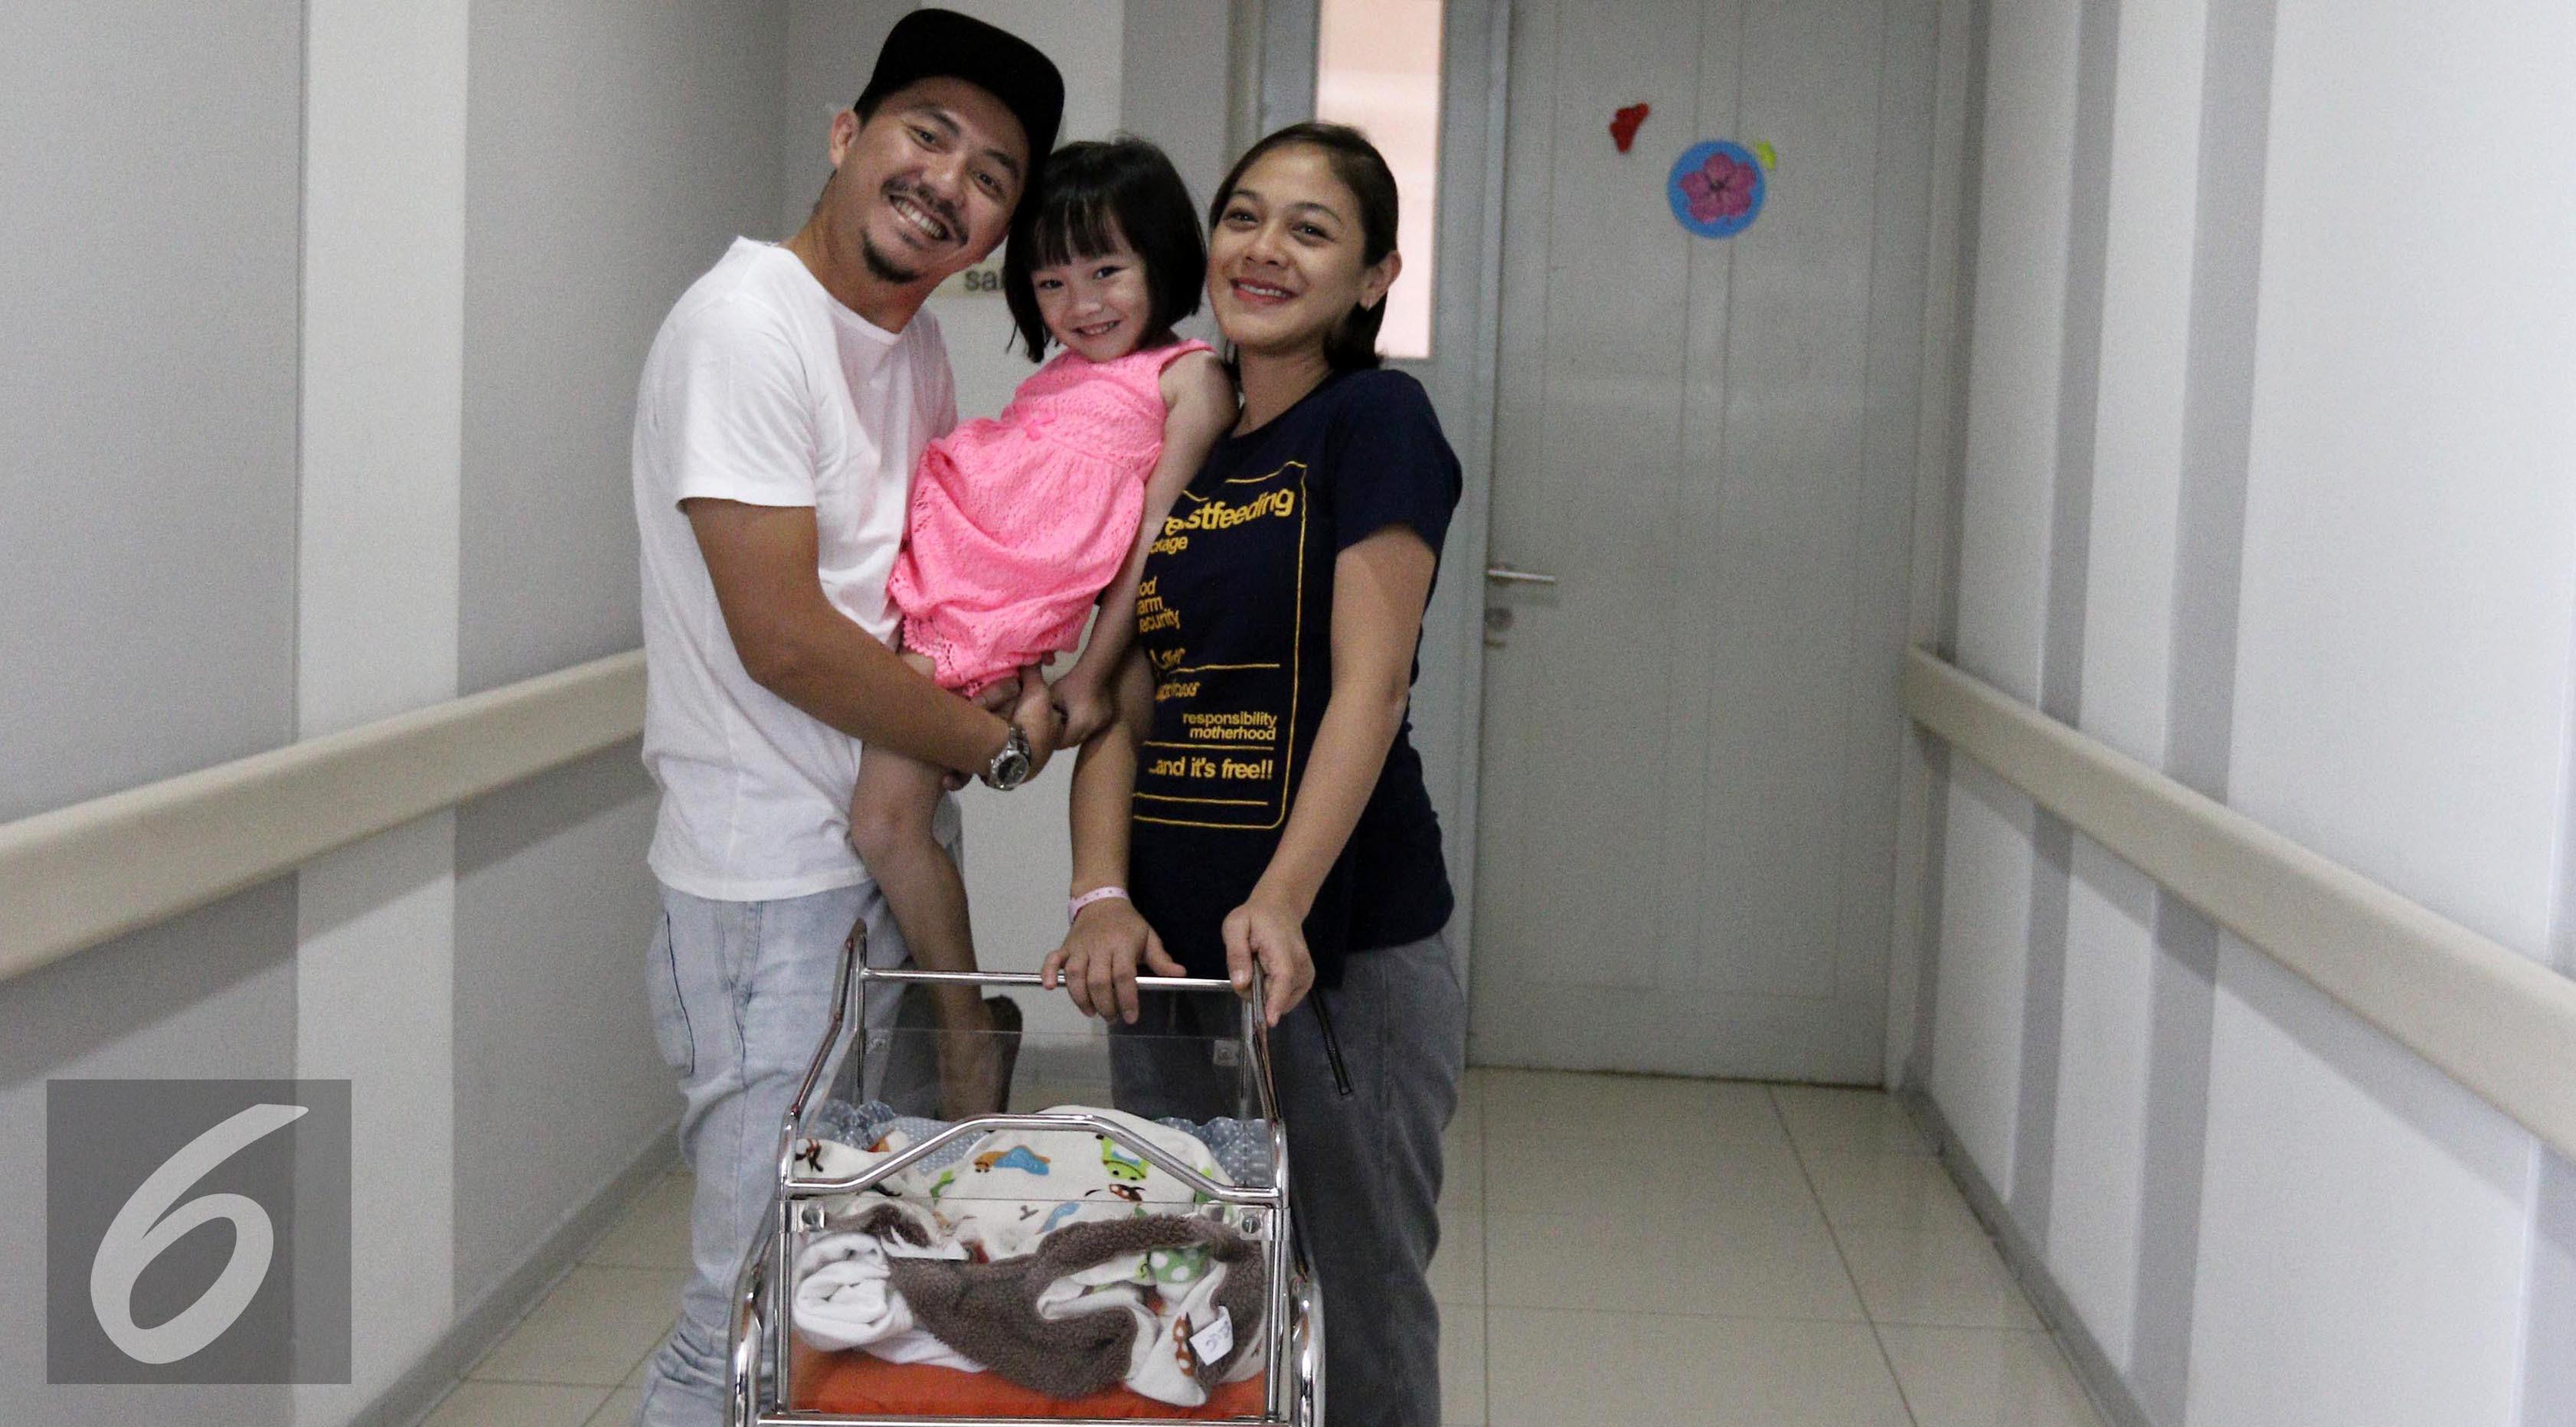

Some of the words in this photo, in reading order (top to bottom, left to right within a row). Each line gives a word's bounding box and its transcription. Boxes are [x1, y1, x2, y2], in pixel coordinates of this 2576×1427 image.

[965, 270, 1005, 291] sa
[1139, 576, 1157, 596] od
[1138, 596, 1162, 613] arm
[1139, 610, 1180, 632] ecurity
[1182, 711, 1277, 728] responsibility
[1190, 727, 1277, 740] motherhood
[1191, 757, 1216, 778] it's
[1222, 759, 1273, 779] free!!
